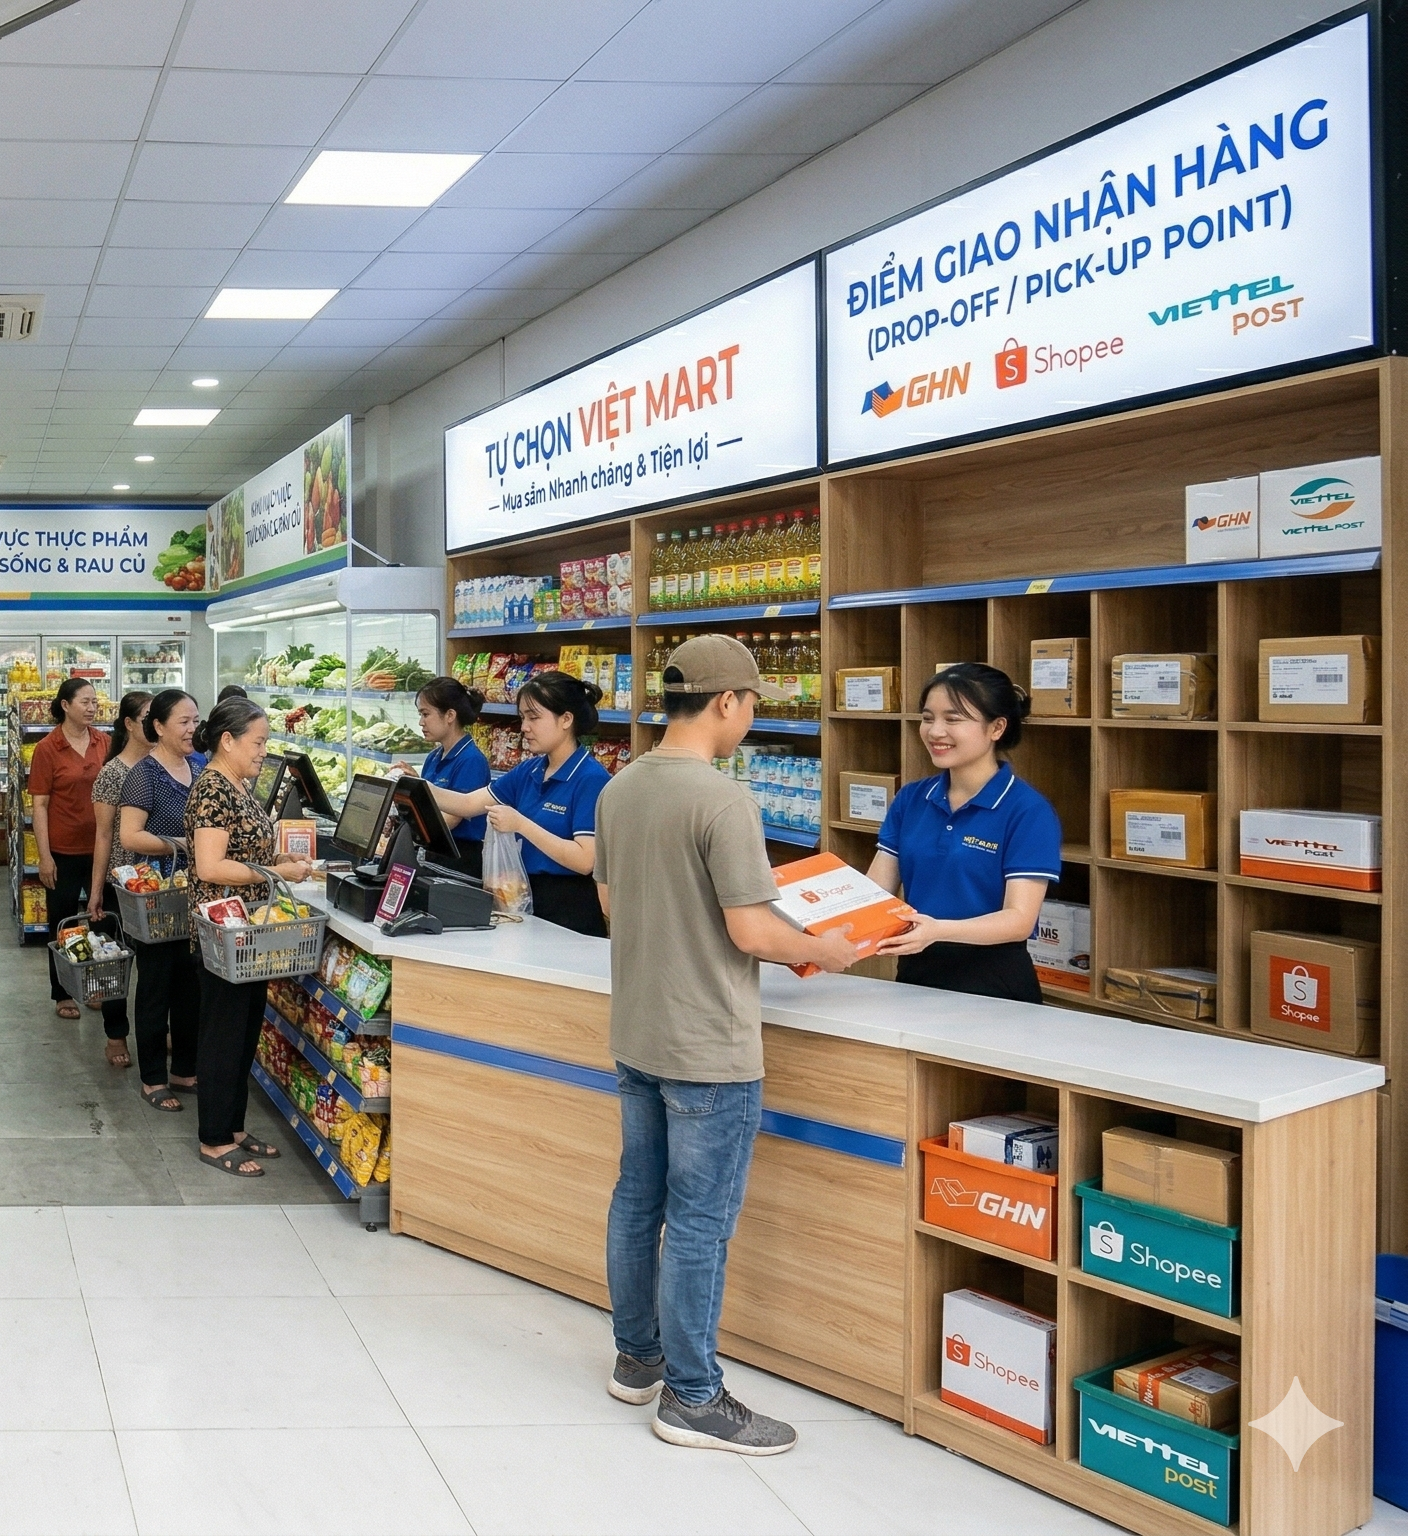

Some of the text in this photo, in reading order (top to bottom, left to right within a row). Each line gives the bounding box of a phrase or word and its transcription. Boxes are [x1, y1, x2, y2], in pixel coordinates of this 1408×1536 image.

[847, 99, 1328, 317] ĐIỂM GIAO NHẬN HÀNG
[867, 287, 999, 361] (DROP-OFF
[1026, 236, 1151, 304] PICK-UP
[1164, 185, 1292, 259] POINT)
[1148, 275, 1294, 326] VIETTEL
[1233, 297, 1304, 335] POST
[1035, 336, 1124, 373] Shopee
[907, 362, 970, 408] GHN
[485, 343, 740, 487] TỰ CHỌN VIỆT MART
[549, 475, 588, 501] Nhanh
[636, 453, 647, 477] &
[650, 443, 683, 478] Tiện
[688, 432, 709, 470] lợi
[1290, 492, 1355, 506] VIETTEL
[35, 529, 87, 551] THỰC
[92, 525, 149, 548] PHẨM
[1217, 511, 1251, 528] GHN
[58, 558, 70, 574] &
[75, 557, 114, 574] RAU
[120, 551, 146, 574] CỦ
[978, 1191, 1046, 1230] GHN
[1130, 1242, 1222, 1289] Shopee
[974, 1352, 1039, 1391] Shopee
[1088, 1417, 1219, 1479] VIETTEL
[1165, 1466, 1217, 1499] post
